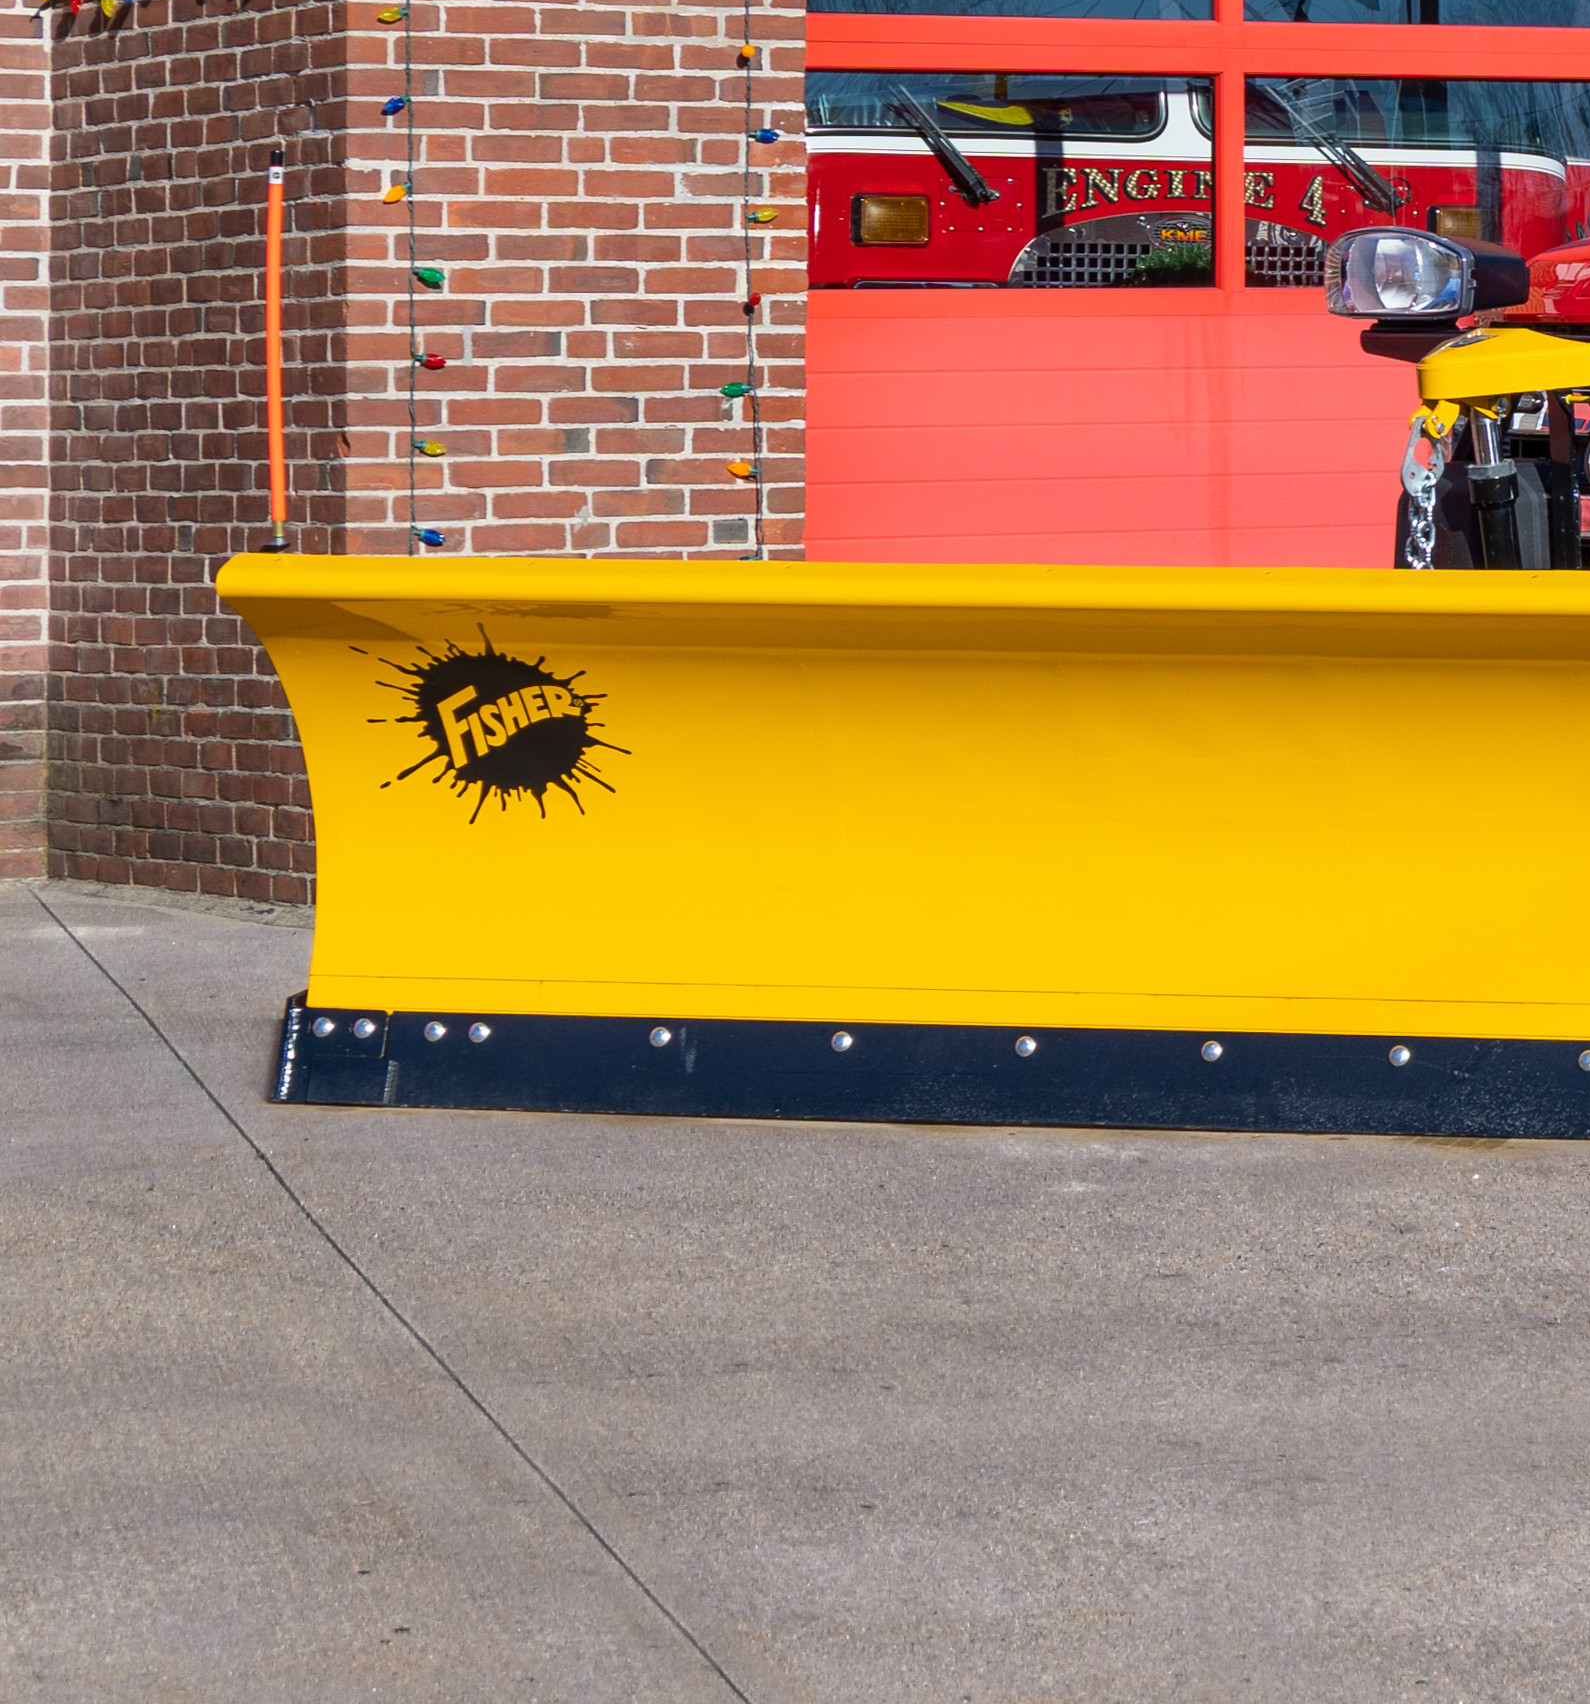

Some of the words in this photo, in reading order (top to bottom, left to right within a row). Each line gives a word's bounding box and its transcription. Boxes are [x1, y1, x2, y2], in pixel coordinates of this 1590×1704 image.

[1298, 174, 1327, 228] 4
[1160, 228, 1209, 243] KME
[437, 684, 582, 770] FISHER
